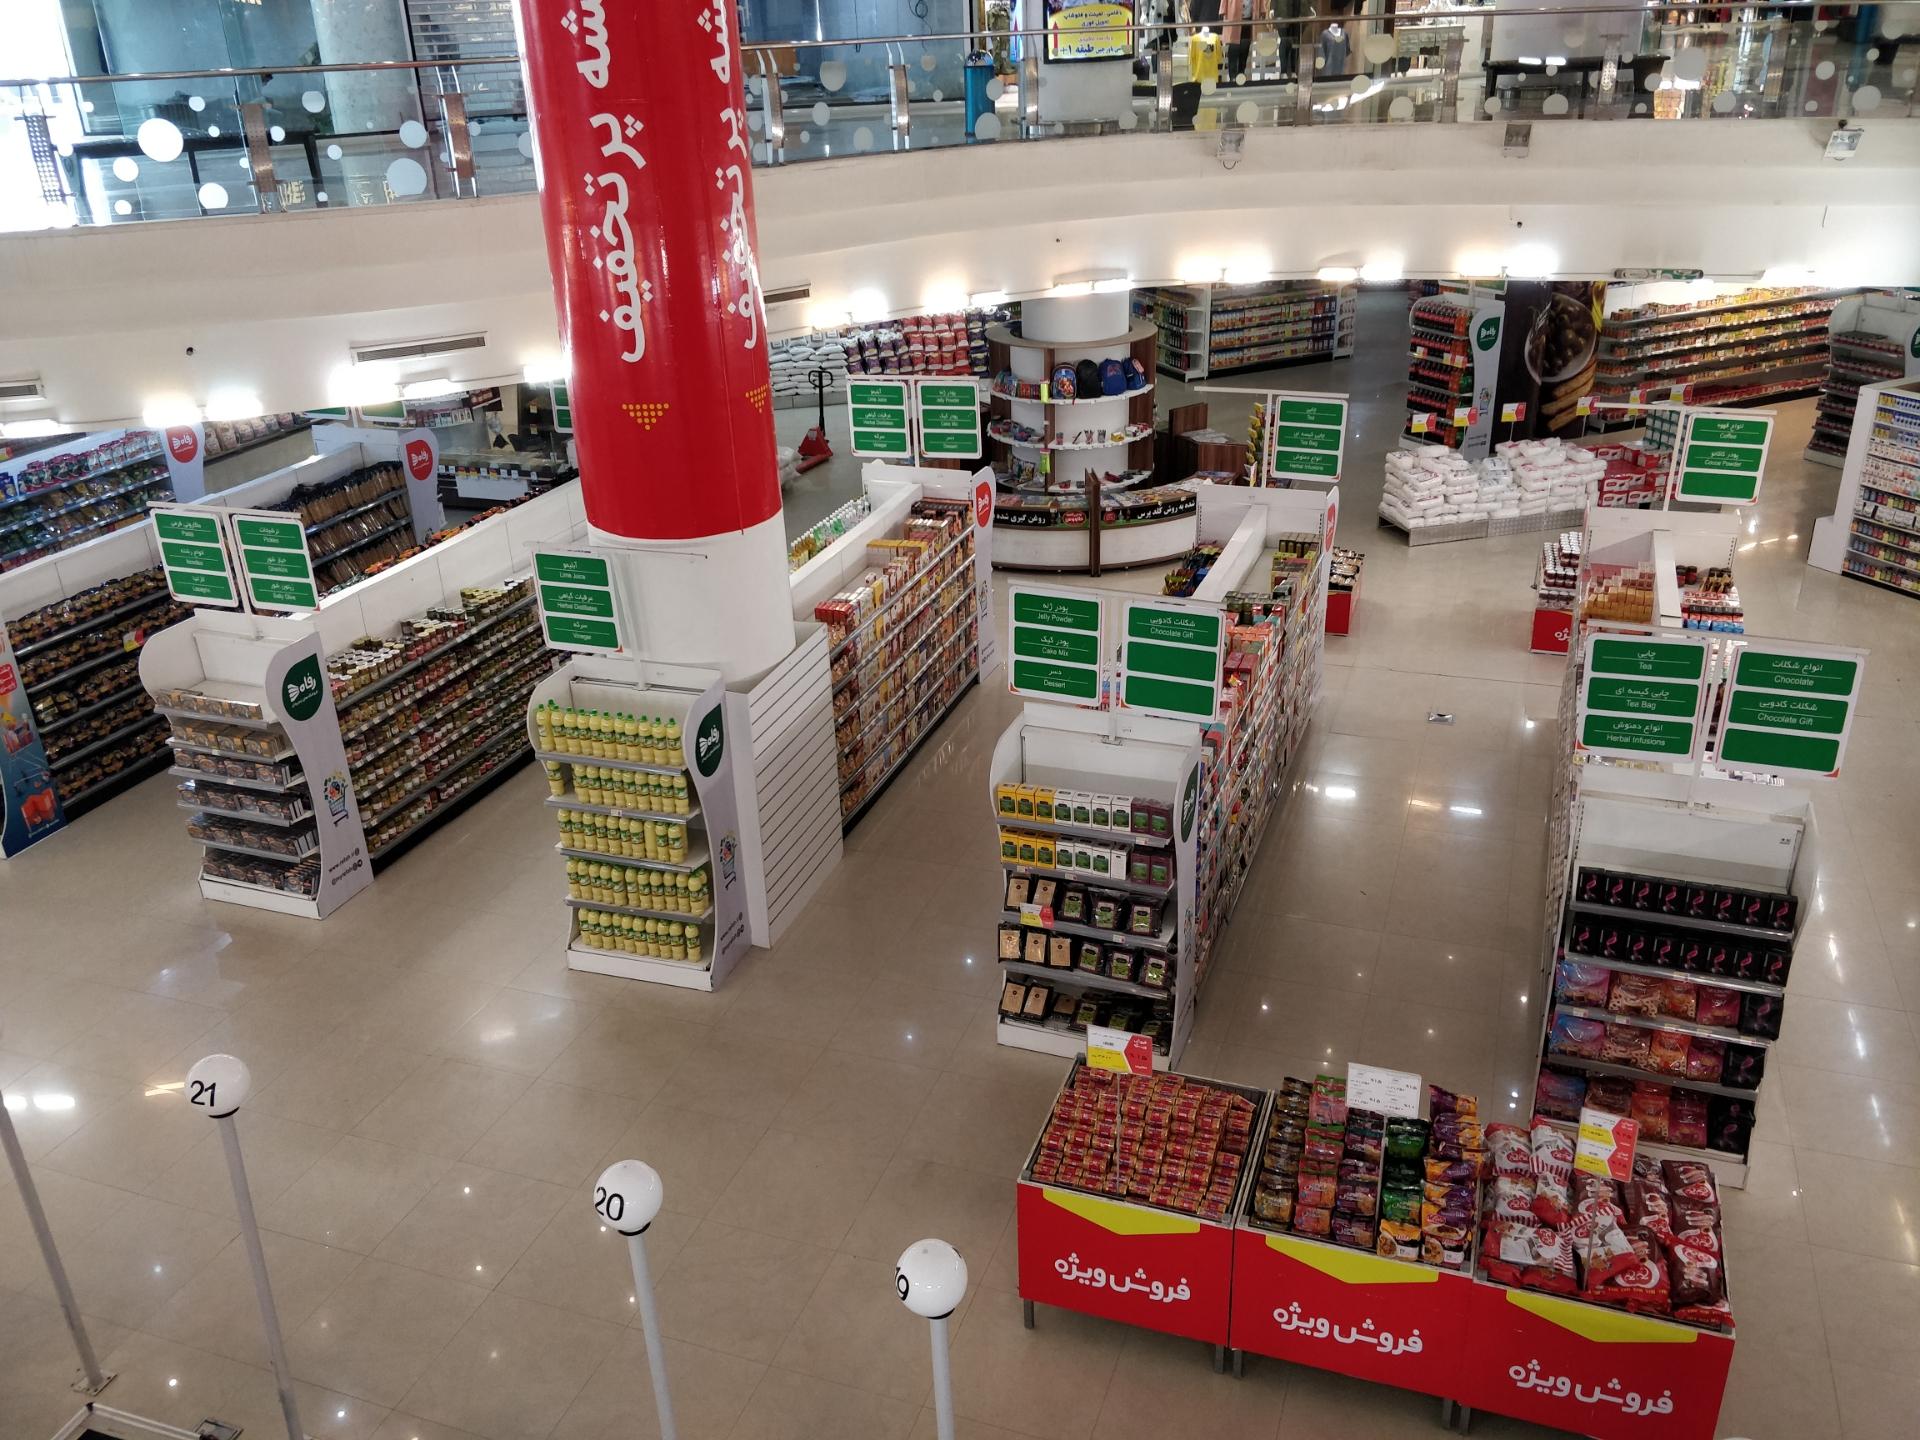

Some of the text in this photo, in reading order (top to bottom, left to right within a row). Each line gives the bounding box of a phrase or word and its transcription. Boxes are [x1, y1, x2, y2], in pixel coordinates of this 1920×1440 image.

[719, 107, 749, 160] پر
[589, 113, 647, 170] پر
[715, 164, 758, 350] تخفیف
[583, 172, 655, 364] تخفیف
[1054, 605, 1069, 614] پودر
[1038, 612, 1074, 624] Jelly Powder
[1173, 618, 1196, 627] شکلات
[1150, 626, 1194, 639] Chocolate Gift
[1042, 646, 1057, 655] Cake
[1055, 640, 1069, 649] پودر
[1639, 661, 1652, 670] Tea
[1772, 660, 1823, 675] انواع شکلات
[1043, 679, 1066, 689] Dessert
[1774, 675, 1814, 686] Chocolate
[1615, 686, 1625, 695] ای
[1627, 687, 1649, 697] کیسه
[1626, 699, 1657, 711] Tea Bag
[1790, 702, 1818, 711] شکلات
[1757, 712, 1814, 726] Chocolate Gift
[1613, 721, 1663, 734] انواع دمنوش
[1606, 733, 1666, 746] Herbal Infusions
[189, 1080, 218, 1107] 21
[594, 1186, 625, 1222] 20
[1054, 1252, 1191, 1302] فروش ویژه
[1273, 1301, 1423, 1354] فروش ویژه
[1509, 1359, 1675, 1416] فروش ویژه
